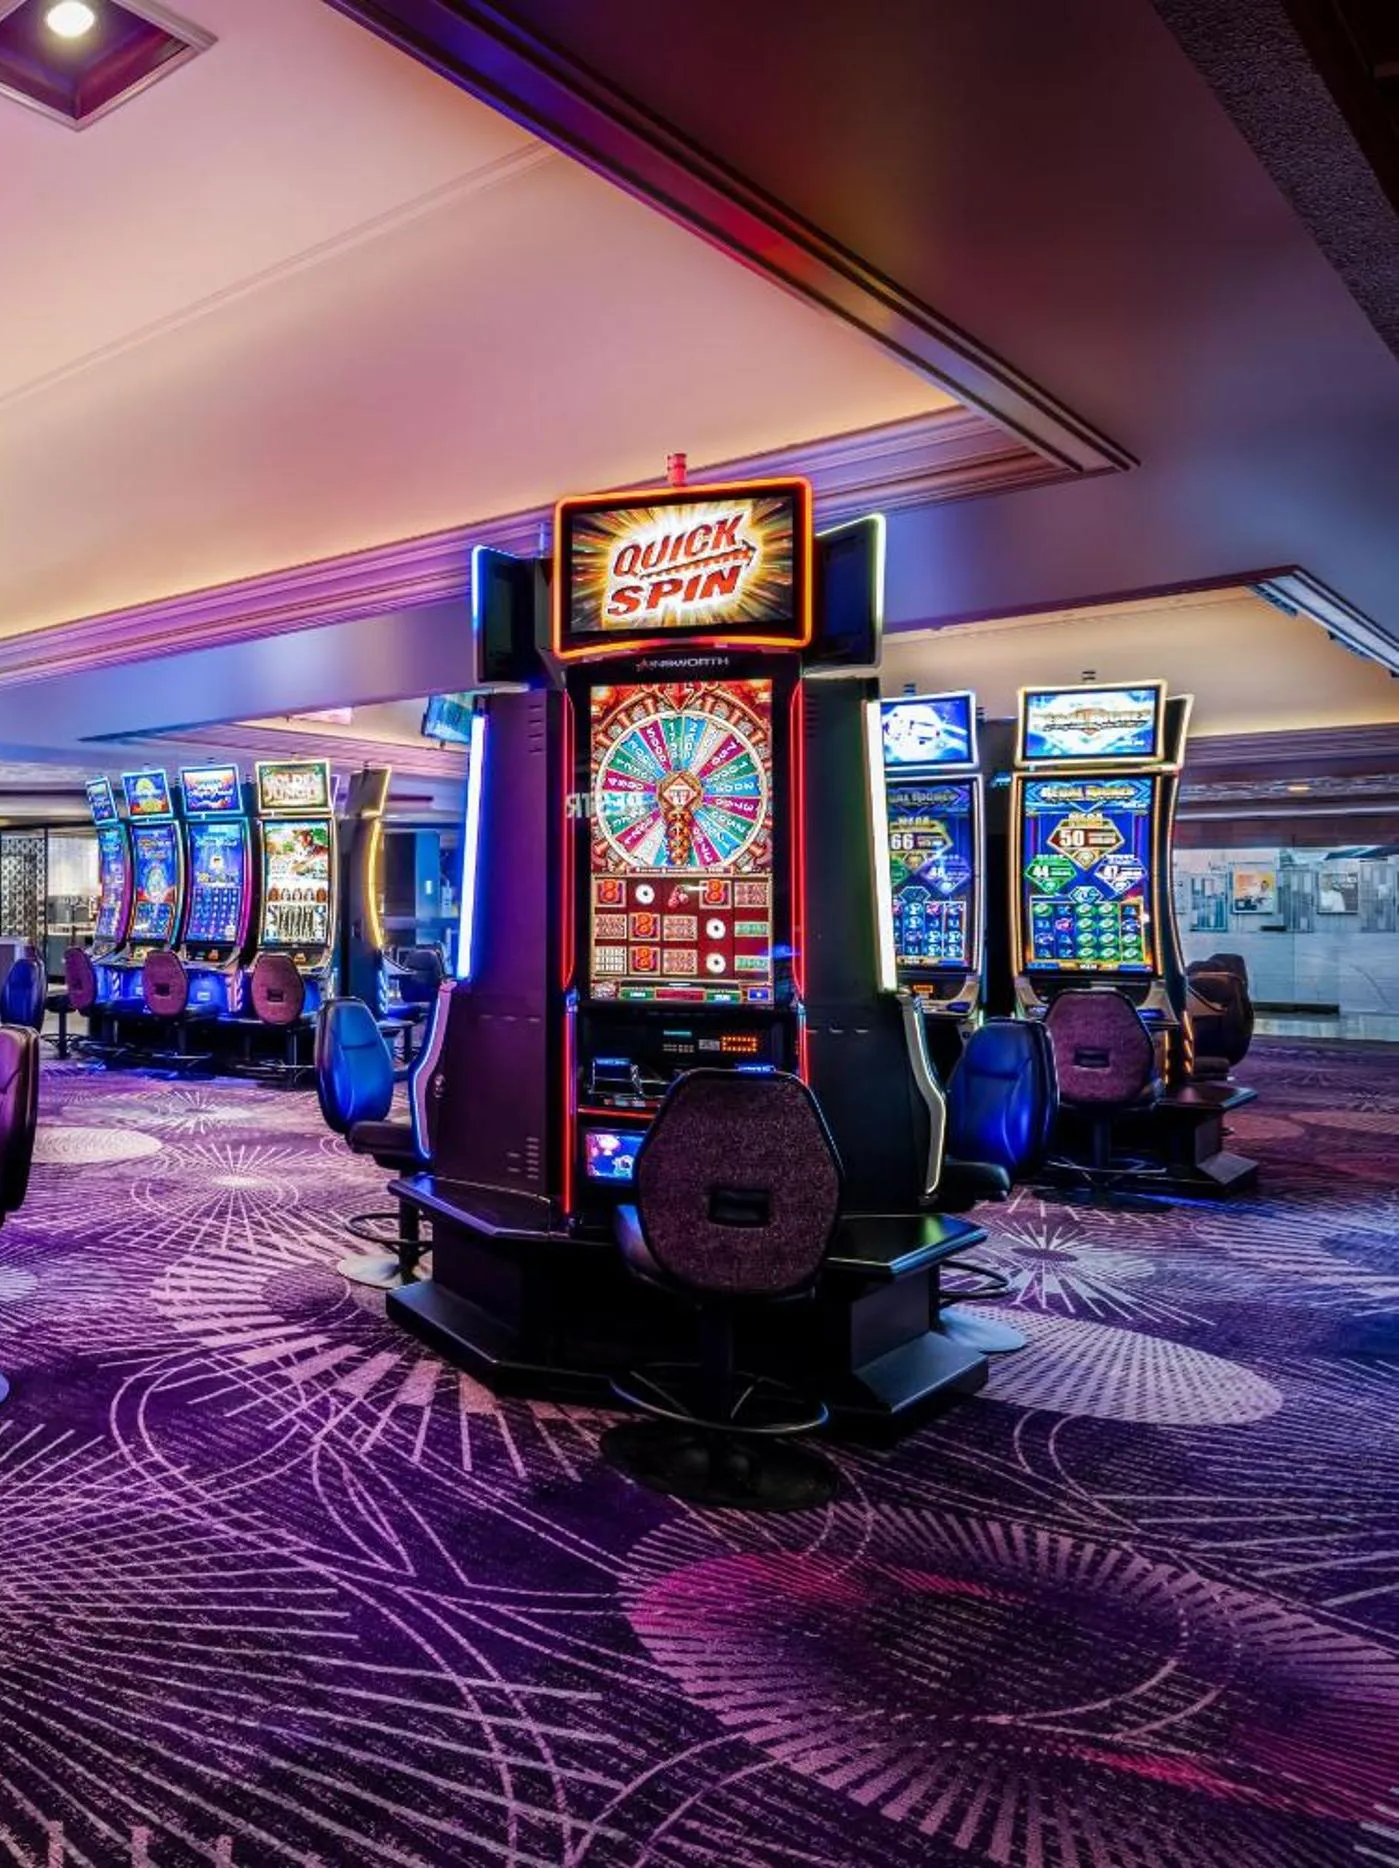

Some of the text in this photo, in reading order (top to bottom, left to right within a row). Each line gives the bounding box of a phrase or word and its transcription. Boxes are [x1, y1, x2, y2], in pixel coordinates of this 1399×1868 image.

[612, 511, 744, 578] QUICK
[607, 563, 742, 617] SPIN
[890, 833, 915, 850] 66
[1059, 829, 1086, 848] 50
